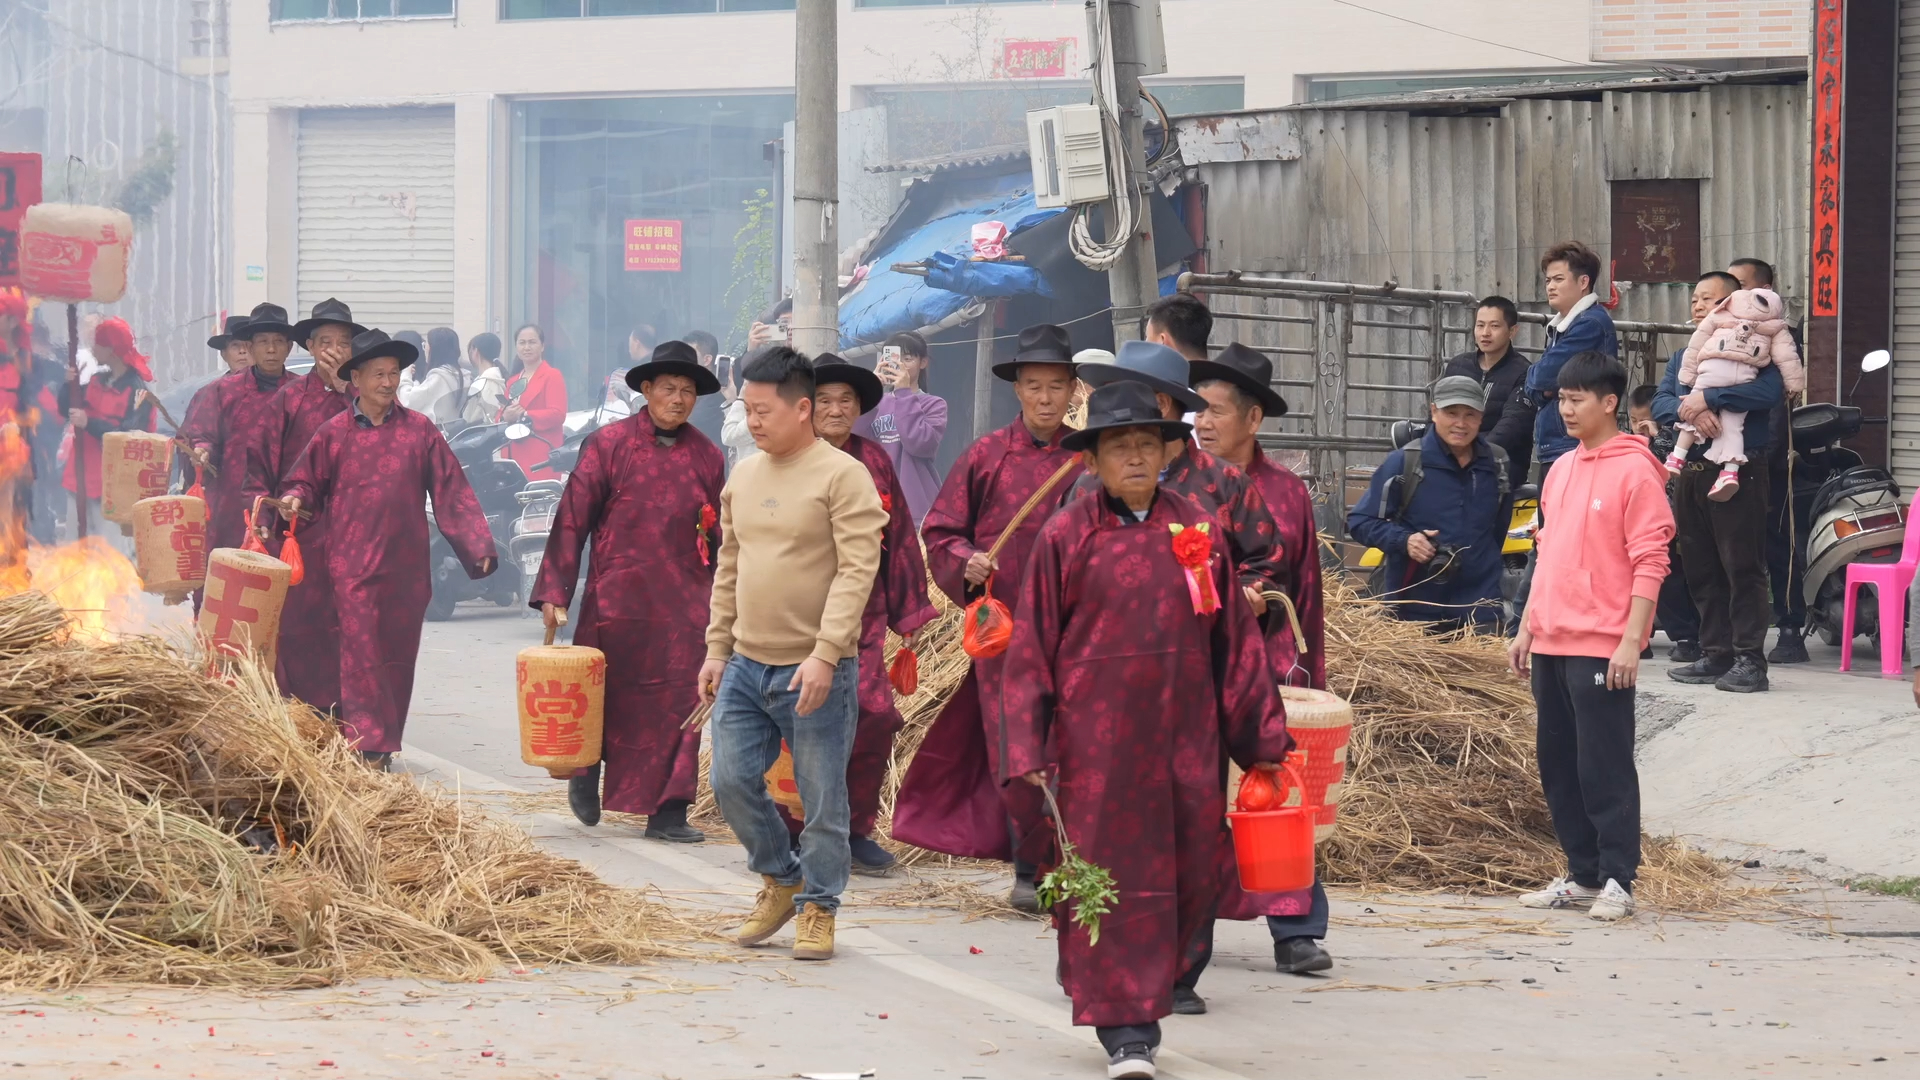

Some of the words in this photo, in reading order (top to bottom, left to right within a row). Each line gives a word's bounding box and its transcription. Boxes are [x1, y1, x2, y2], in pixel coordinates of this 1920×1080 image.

[633, 226, 673, 237] 旺铺招租
[123, 440, 153, 462] 部
[150, 500, 184, 527] 部
